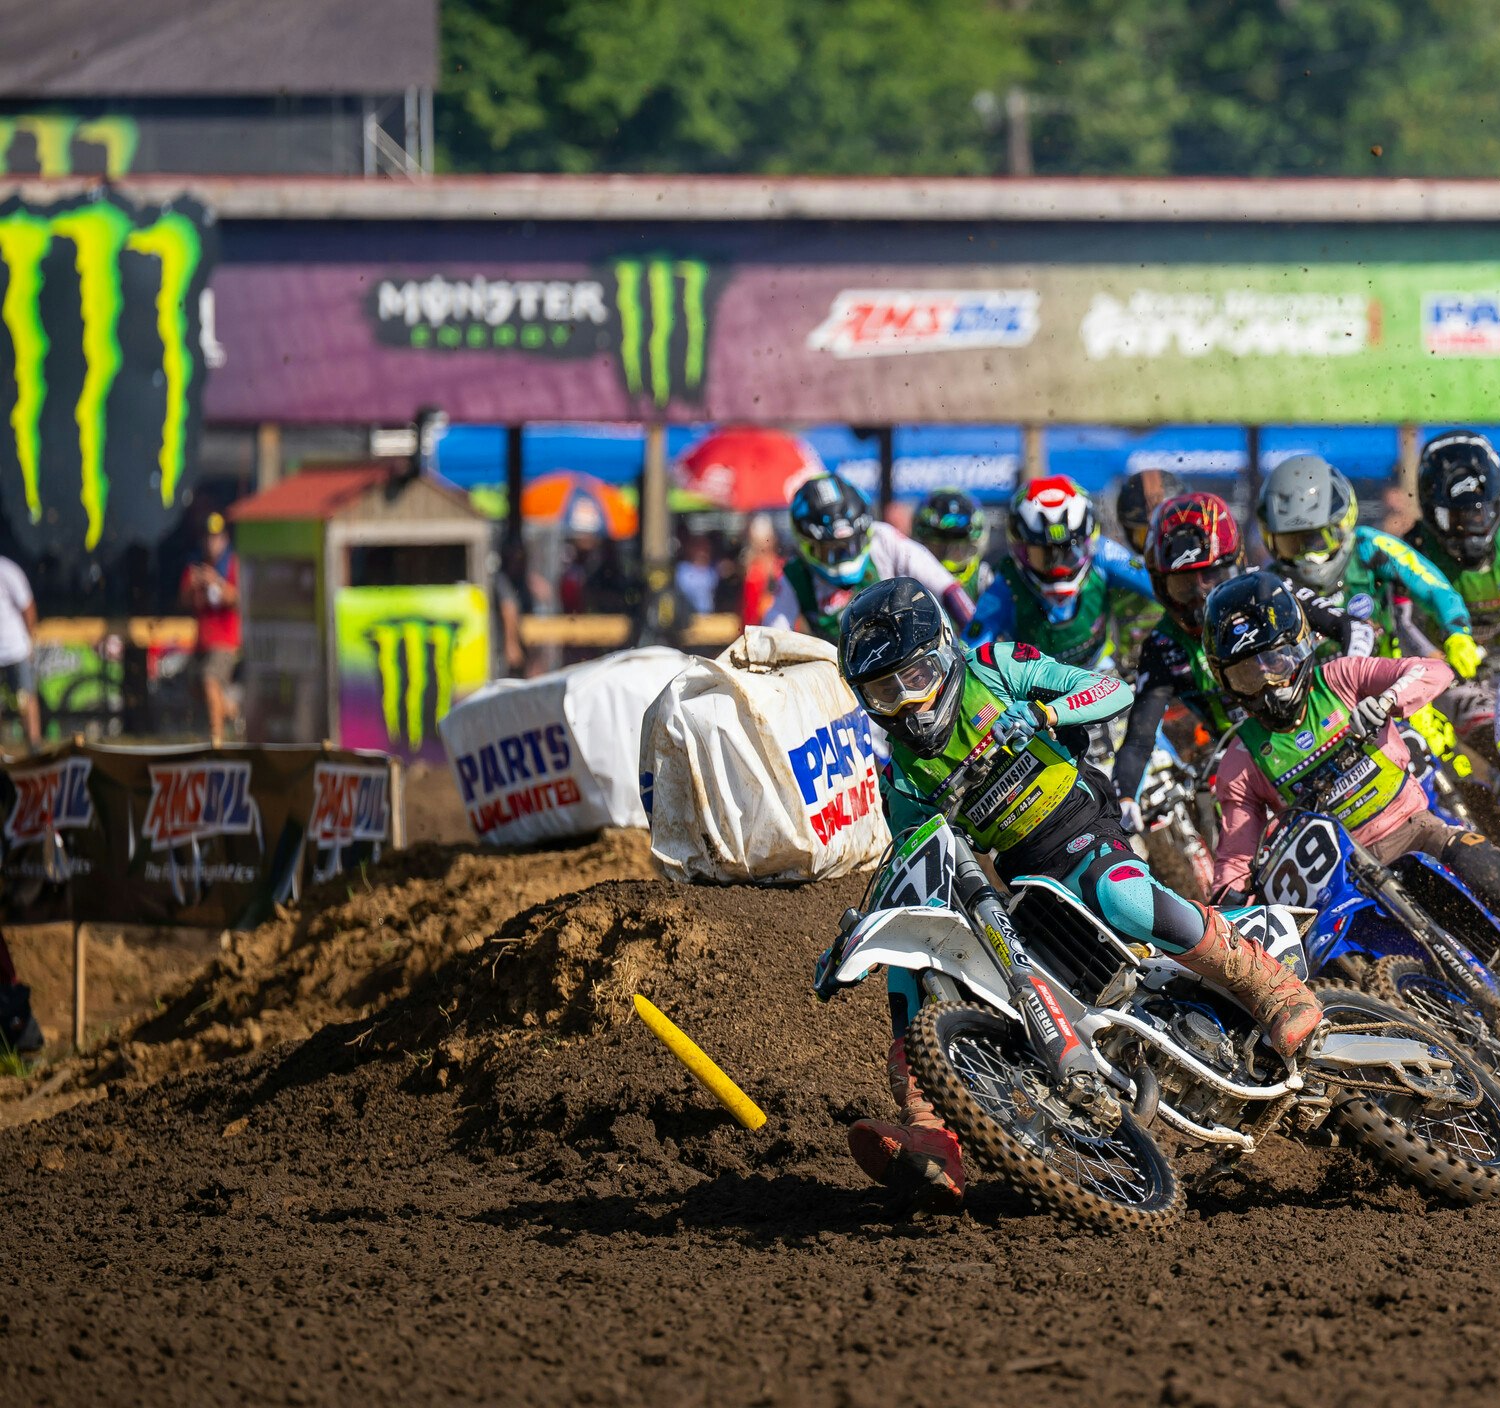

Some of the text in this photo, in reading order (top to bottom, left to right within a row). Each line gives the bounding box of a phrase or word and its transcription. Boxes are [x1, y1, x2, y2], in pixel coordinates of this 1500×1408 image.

[378, 275, 606, 325] MONSTER
[456, 722, 572, 802] PARTS
[969, 754, 1034, 824] CHAMPIONSHIP
[148, 769, 250, 842] AMSOIL
[1272, 823, 1339, 908] 39
[1025, 991, 1060, 1046] PIRELLI
